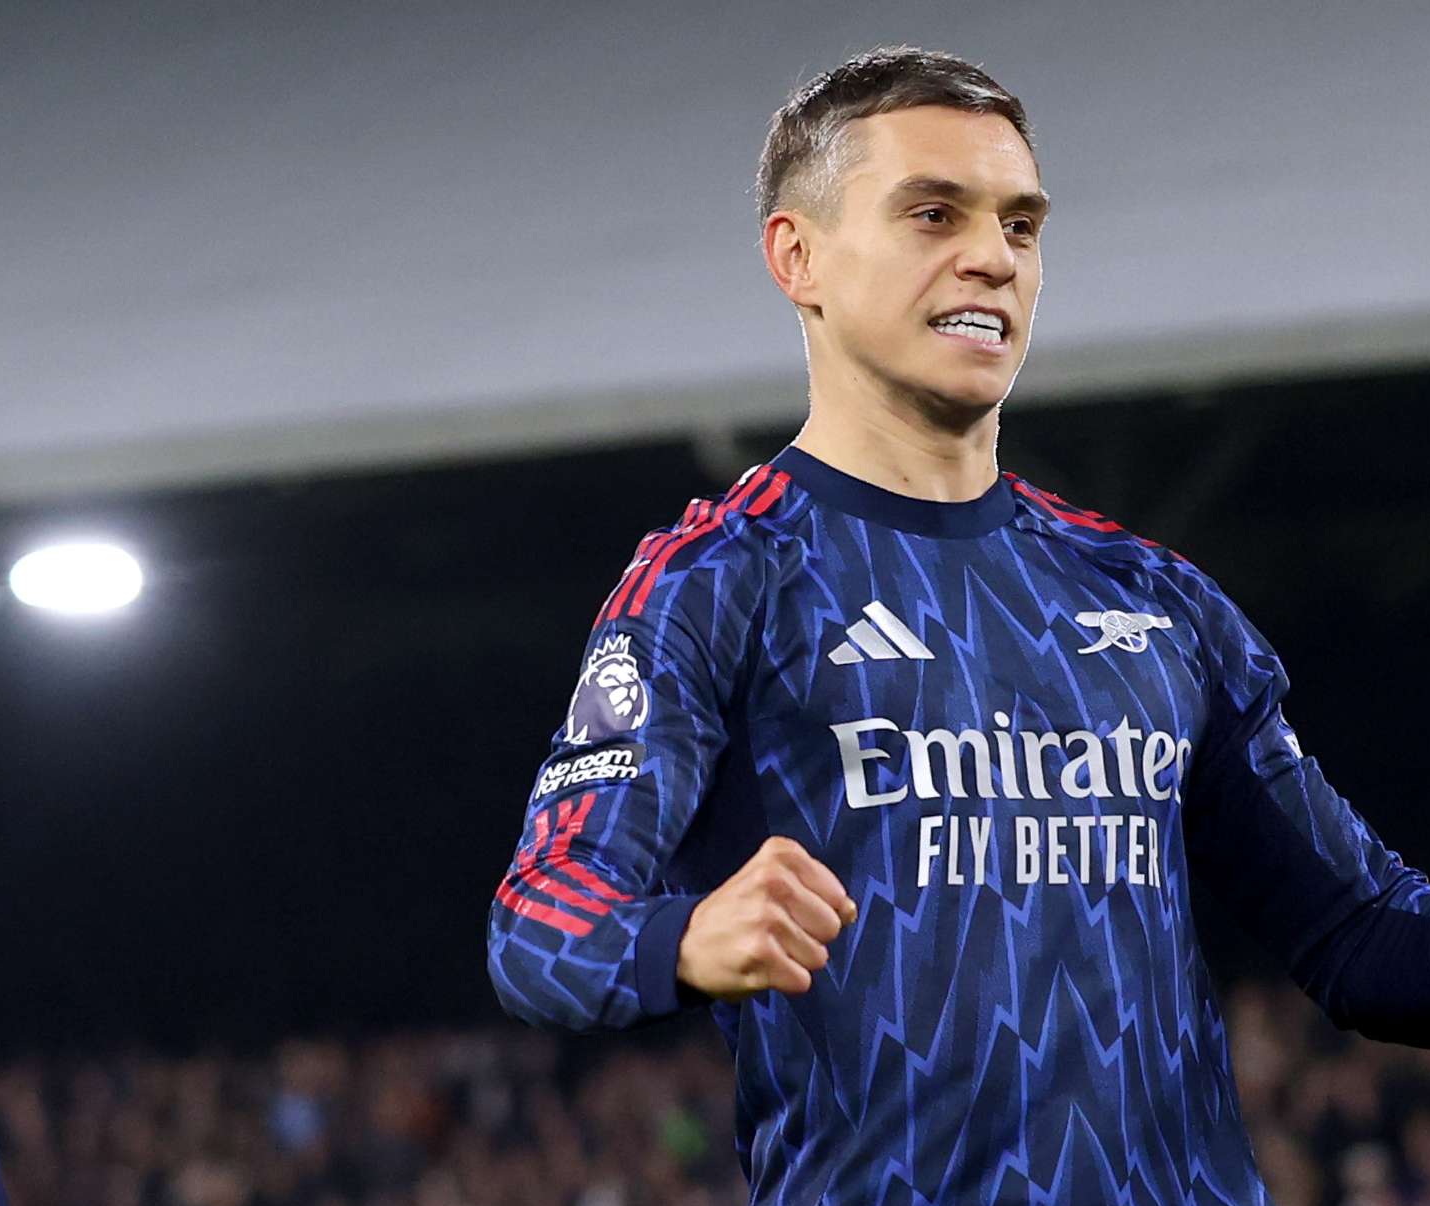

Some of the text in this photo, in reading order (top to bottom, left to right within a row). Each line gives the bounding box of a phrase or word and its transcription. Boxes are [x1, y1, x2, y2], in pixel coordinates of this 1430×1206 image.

[539, 749, 633, 785] No room
[562, 765, 639, 788] racism
[917, 815, 1161, 889] FLY BETTER
